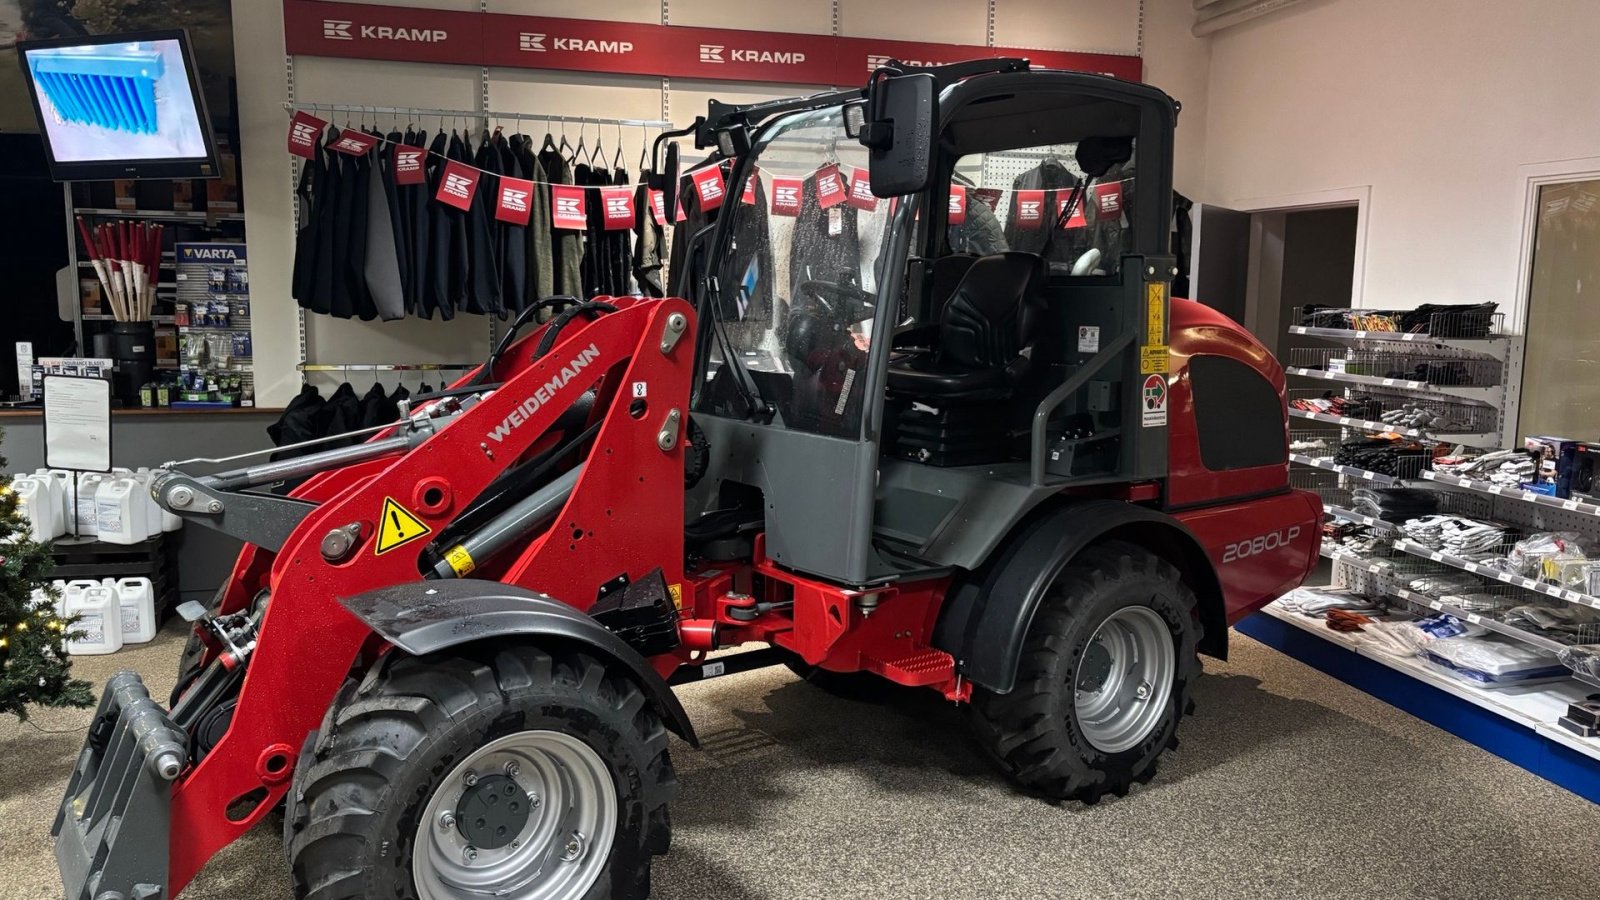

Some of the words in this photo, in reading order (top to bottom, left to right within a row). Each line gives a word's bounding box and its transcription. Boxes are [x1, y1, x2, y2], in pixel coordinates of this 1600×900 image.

[361, 25, 447, 42] KRAMP
[554, 37, 634, 54] KRAMP
[731, 49, 805, 65] KRAMP
[443, 188, 468, 199] KRAMP
[502, 203, 526, 212] KRAMP
[194, 248, 237, 259] VARTA
[486, 343, 601, 443] WEIDEMANN
[1222, 526, 1301, 564] 2080LP
